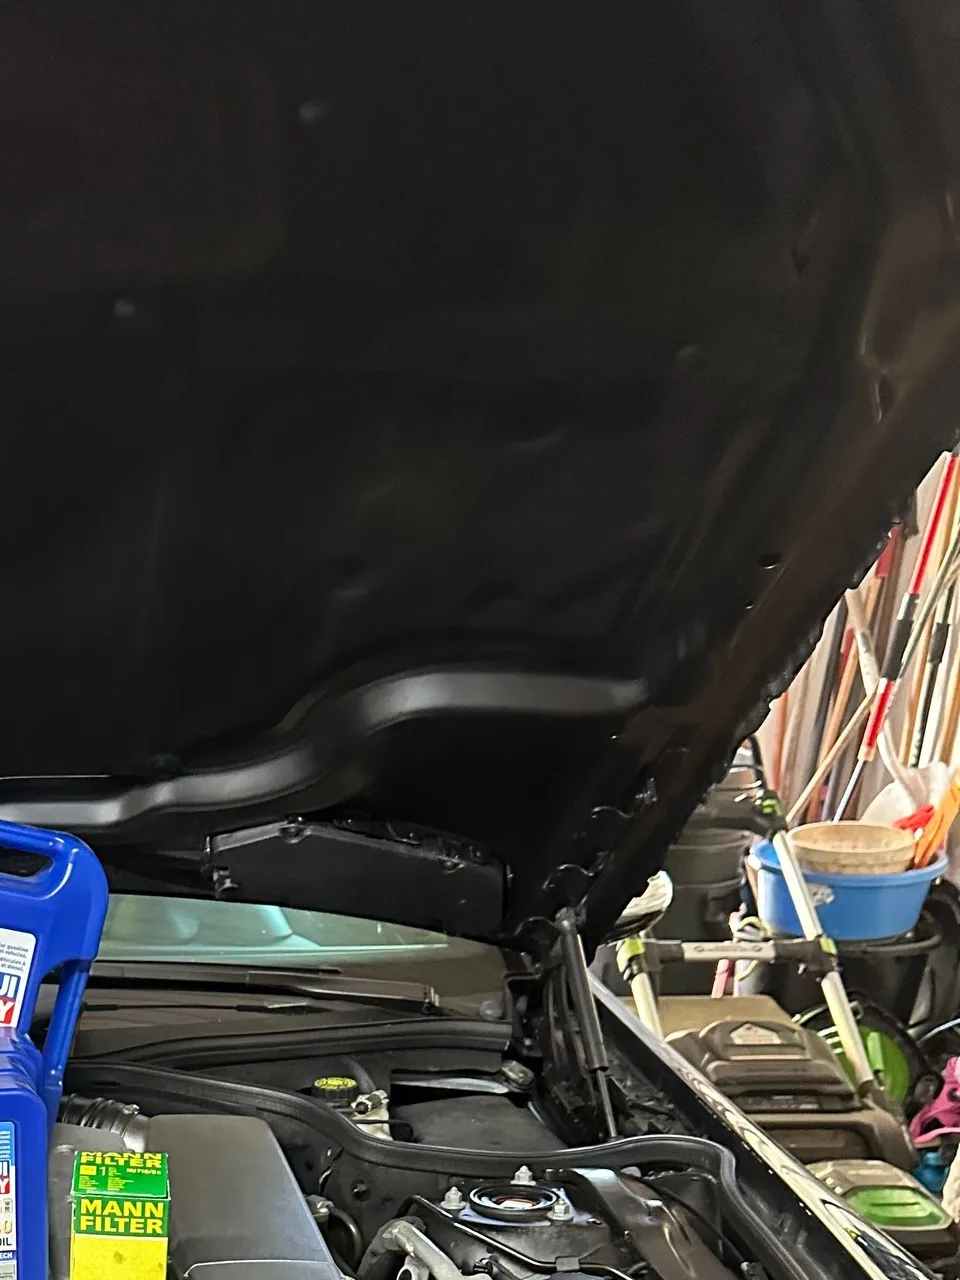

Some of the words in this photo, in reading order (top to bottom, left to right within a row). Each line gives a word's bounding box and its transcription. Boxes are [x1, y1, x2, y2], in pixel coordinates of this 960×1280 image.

[7, 944, 28, 952] gasoline
[81, 1156, 162, 1168] FILTER
[99, 1166, 106, 1176] 1
[81, 1199, 163, 1217] MANN
[80, 1216, 163, 1234] FILTER
